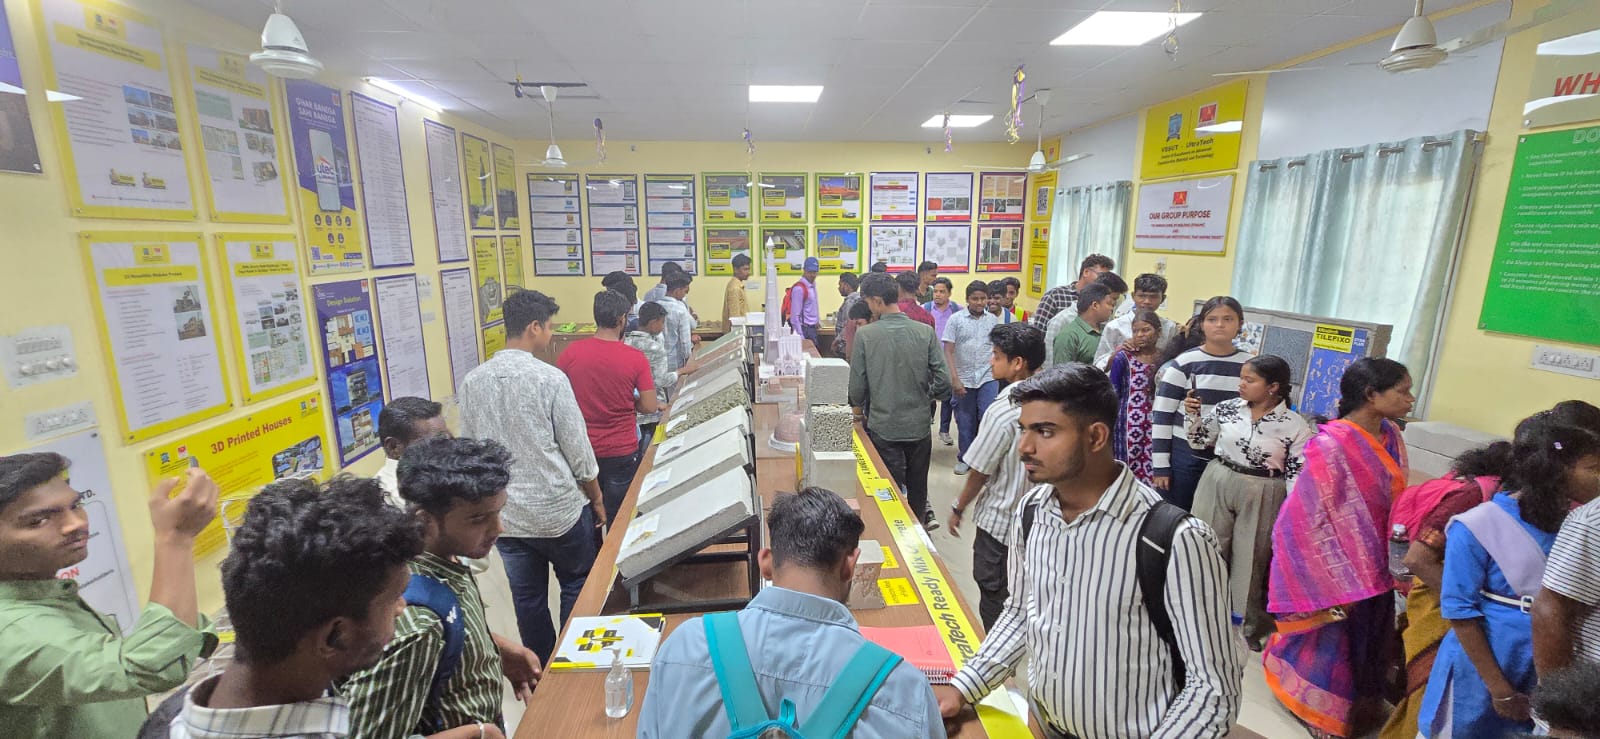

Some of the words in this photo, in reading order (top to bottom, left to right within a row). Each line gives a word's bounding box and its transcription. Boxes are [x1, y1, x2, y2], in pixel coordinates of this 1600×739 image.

[1572, 128, 1600, 145] DO
[1149, 211, 1161, 220] OUR
[1162, 210, 1182, 219] GROUP
[1182, 209, 1212, 219] PURPOSE
[1316, 333, 1351, 344] TILEFIXO
[211, 440, 225, 455] 3D
[226, 426, 261, 449] Printed
[262, 416, 293, 434] Houses
[894, 519, 919, 555] Crete
[911, 556, 931, 574] Mix
[921, 576, 951, 611] Ready
